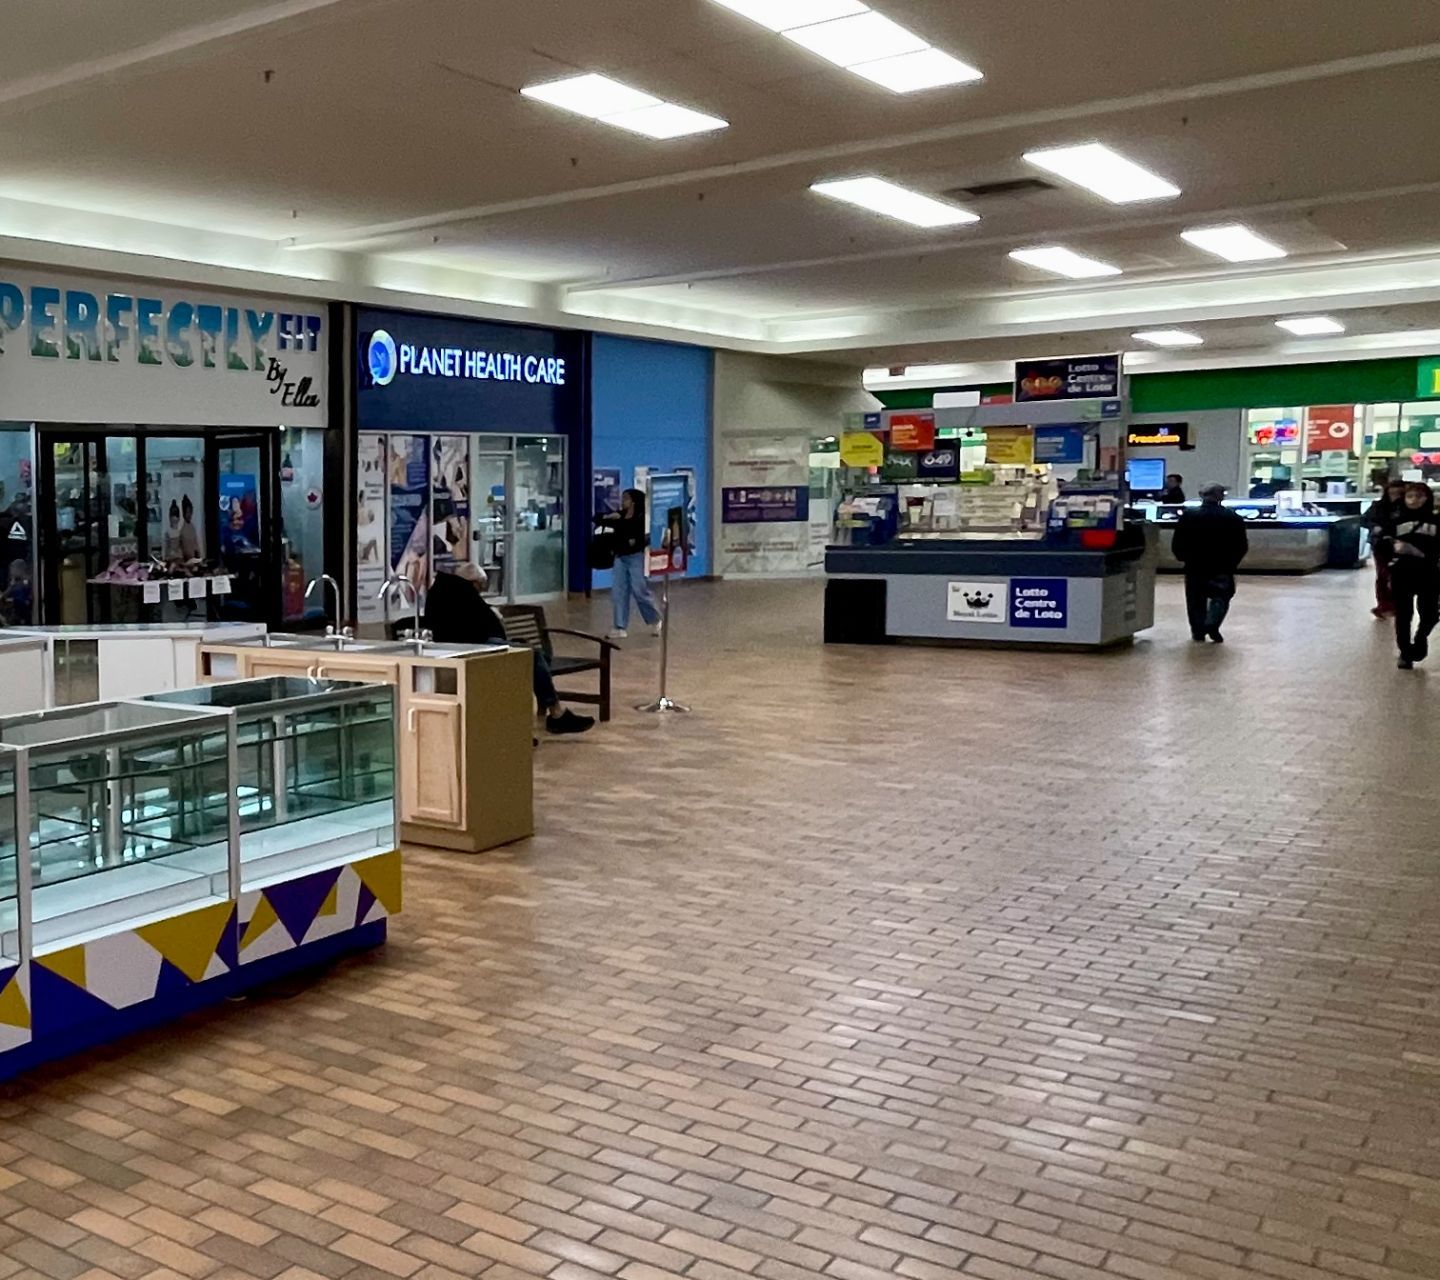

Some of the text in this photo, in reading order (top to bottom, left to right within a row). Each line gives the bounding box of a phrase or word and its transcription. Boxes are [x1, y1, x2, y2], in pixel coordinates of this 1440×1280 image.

[278, 313, 321, 352] FIT
[399, 343, 565, 385] PLANET HEALTH CARE
[1068, 363, 1099, 373] Lotto
[266, 357, 287, 394] By
[1015, 587, 1049, 597] Lotto
[1014, 597, 1057, 608] Centre
[1014, 608, 1063, 619] de Loto
